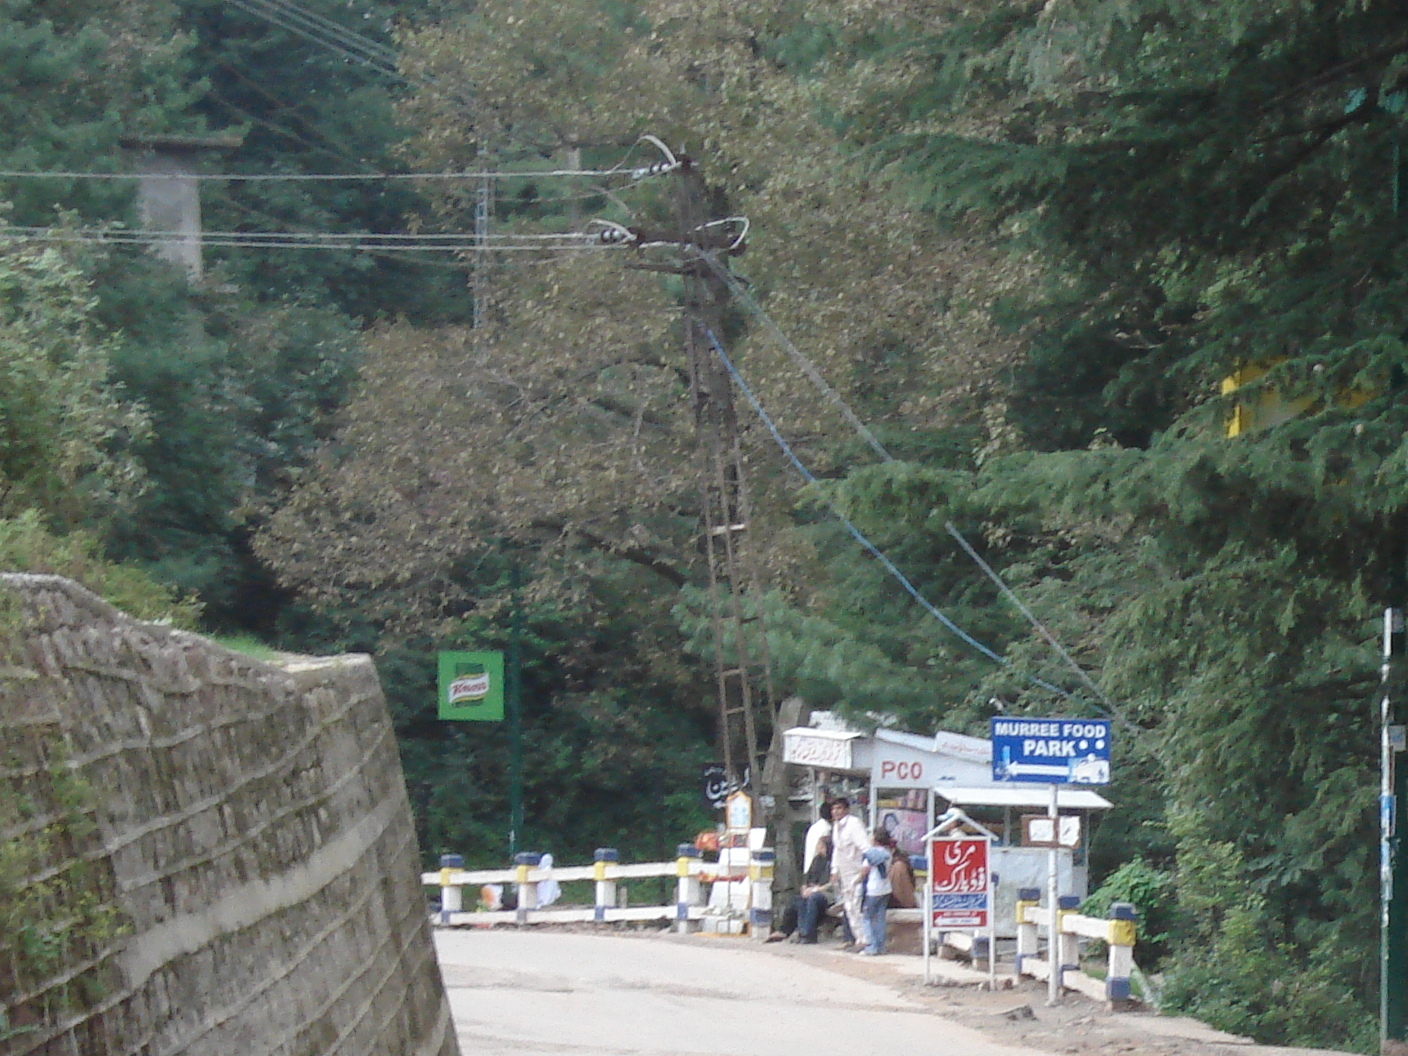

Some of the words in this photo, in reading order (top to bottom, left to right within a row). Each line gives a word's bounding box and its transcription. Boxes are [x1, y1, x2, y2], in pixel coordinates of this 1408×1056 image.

[994, 722, 1060, 737] MURREE
[1062, 724, 1106, 738] FOOD
[1023, 740, 1077, 757] PARK
[881, 760, 923, 780] PCO
